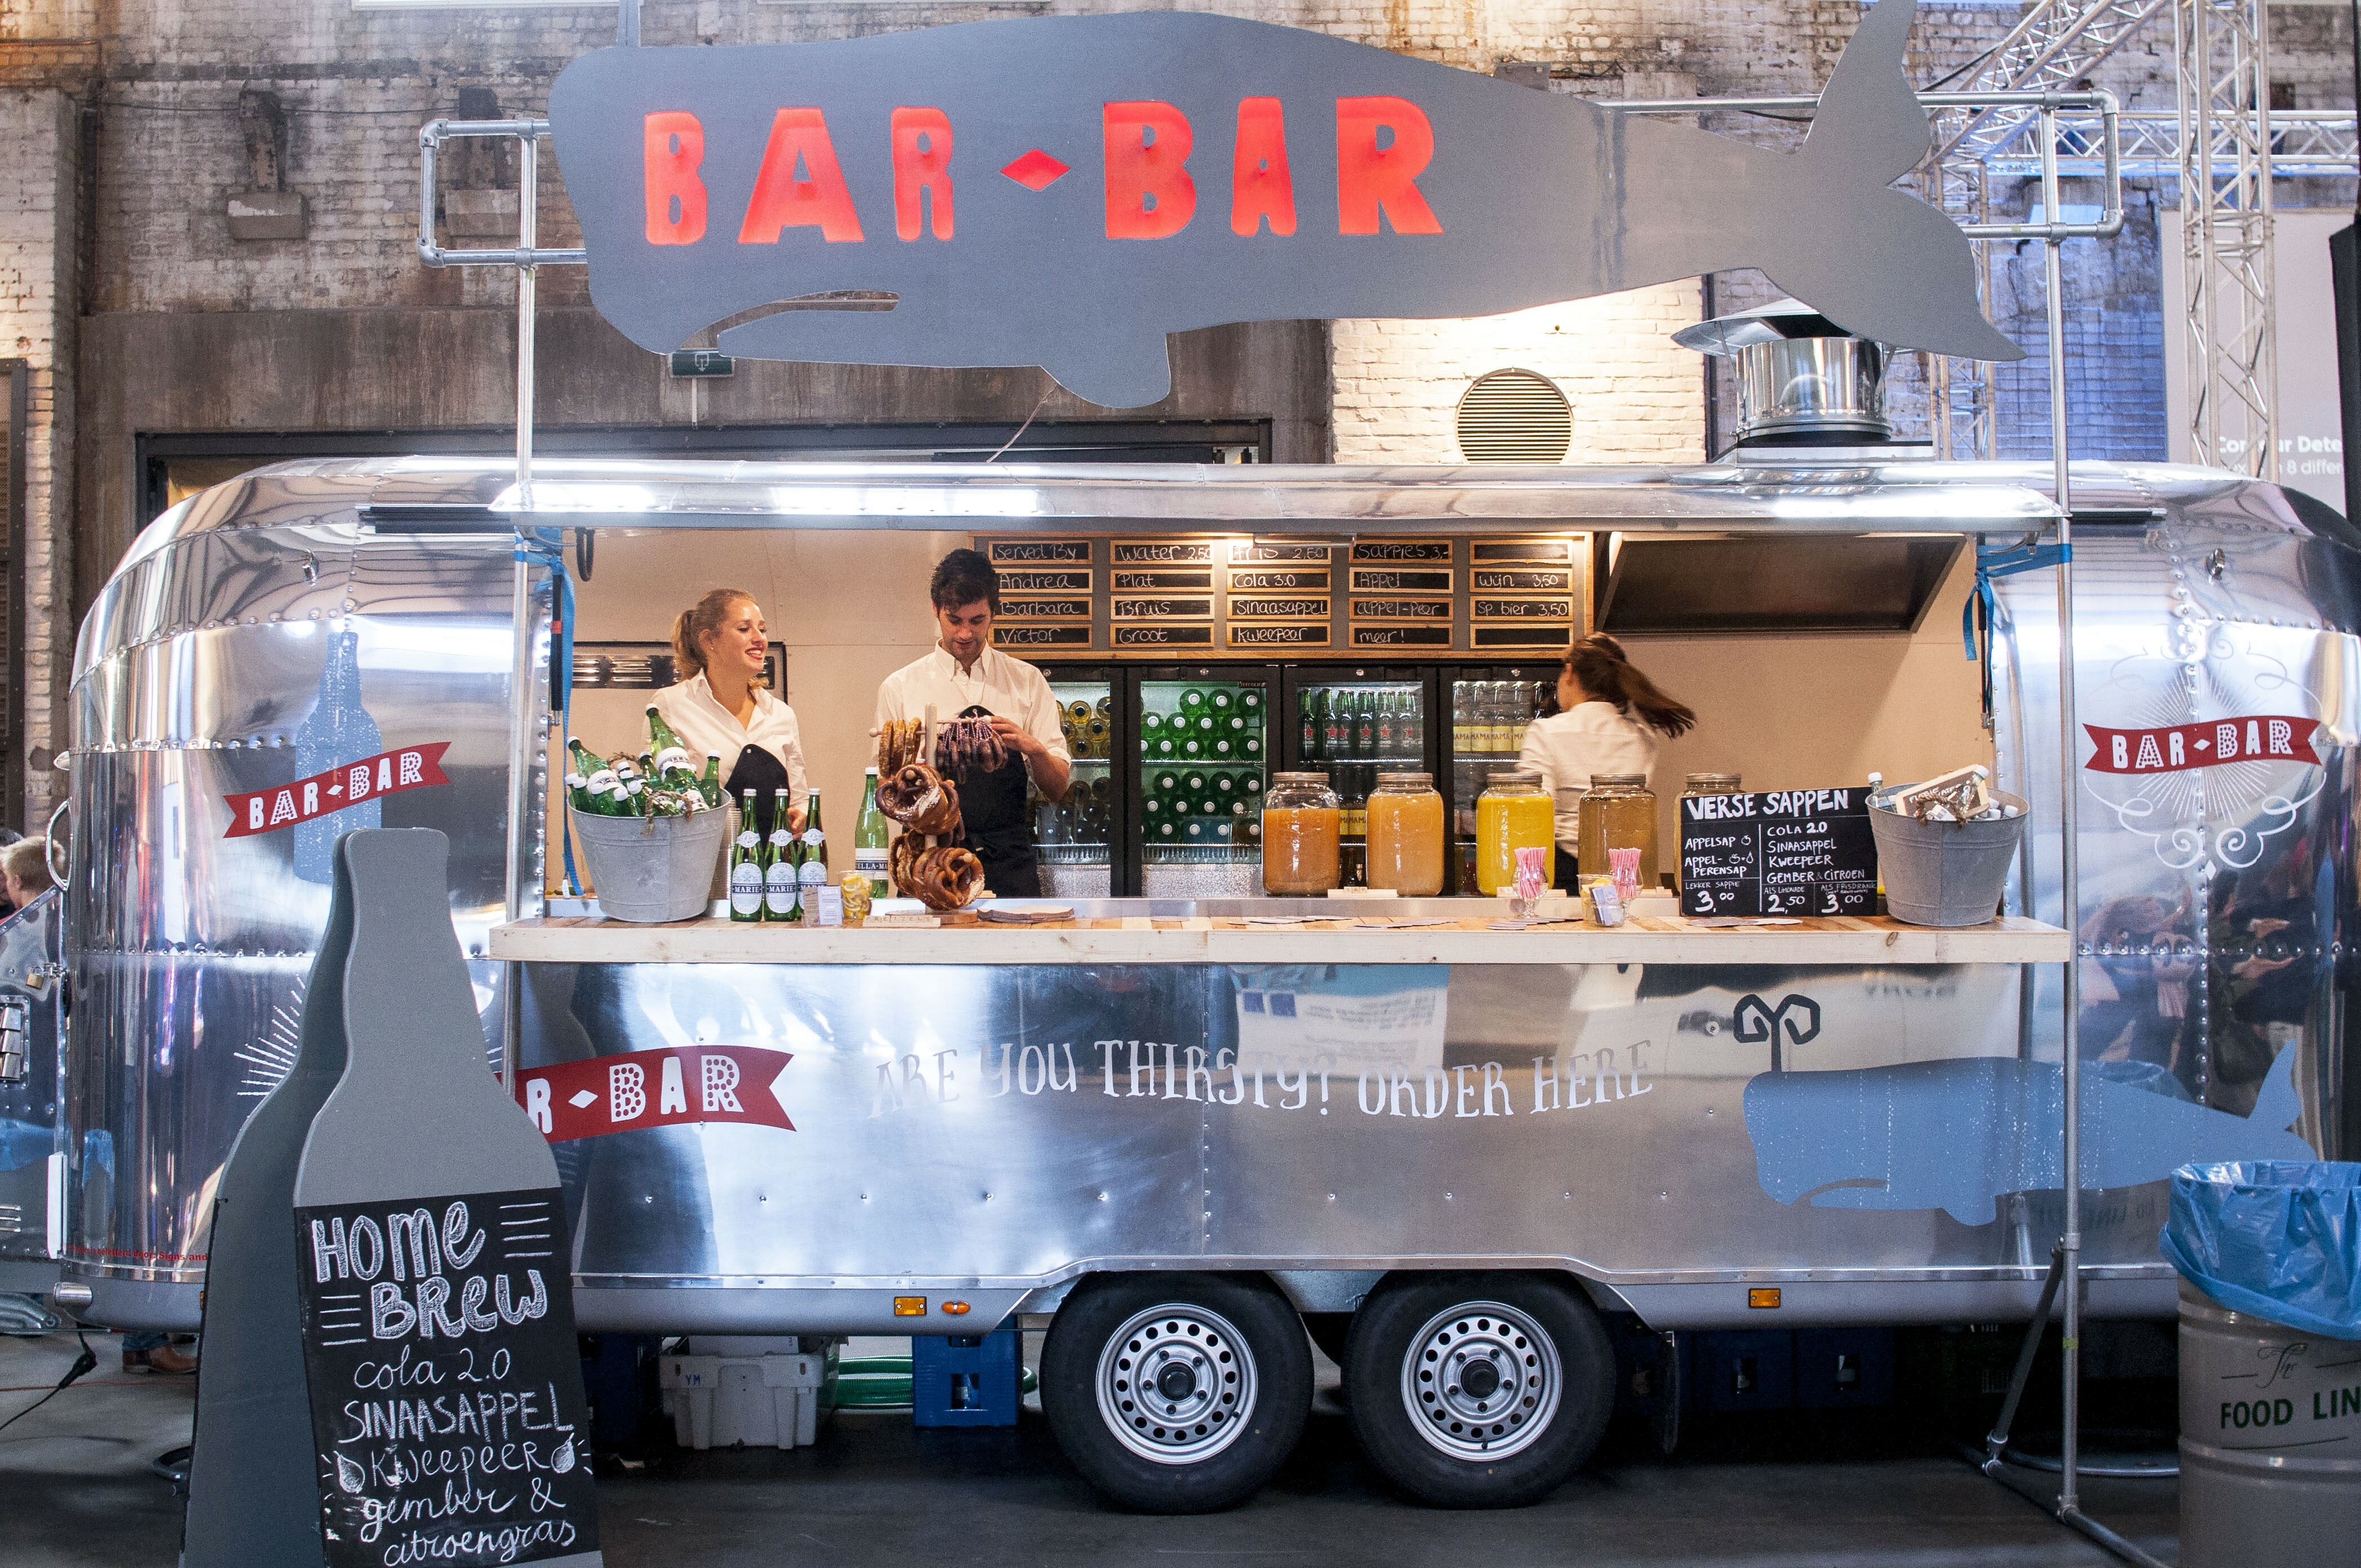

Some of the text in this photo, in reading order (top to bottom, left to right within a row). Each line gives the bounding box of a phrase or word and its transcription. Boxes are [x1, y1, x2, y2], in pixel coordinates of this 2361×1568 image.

[643, 96, 1445, 245] BAR BAR
[995, 543, 1076, 562] Served By
[1119, 544, 1180, 561] Water
[999, 573, 1077, 590] Andrea
[1117, 574, 1156, 588] Plat
[1234, 573, 1296, 587] Cola 3.0
[1532, 574, 1559, 588] 3,50
[1000, 600, 1080, 615] Barbara
[1118, 601, 1171, 617] Bruis
[1538, 603, 1567, 617] 3,50
[1001, 627, 1061, 644] Victor
[1119, 627, 1168, 643] Groot
[2112, 719, 2293, 769] BAR BAR
[249, 751, 423, 830] BAR BAR
[1686, 790, 1849, 820] VERSE SAPPEN
[1767, 821, 1828, 837] COLA 2.0
[1685, 836, 1736, 851] APPELSAP
[1766, 838, 1837, 855] SINAASAPPEL
[1684, 856, 1722, 868] APPEL-
[1769, 854, 1834, 868] KWEEPEER
[1693, 866, 1747, 878] PERENSAP
[1767, 871, 1815, 884] GEMBER
[1685, 881, 1711, 890] LEKKER
[1763, 886, 1776, 894] ALS
[866, 1039, 1653, 1119] ARE YOU THIRSTY? ORDER HERE
[609, 1055, 744, 1123] BAR
[354, 1344, 511, 1390] cola 2.0
[338, 1382, 575, 1444] SINAASAPPEL
[2221, 1398, 2294, 1429] FOOD
[360, 1477, 566, 1543] gember &
[384, 1519, 576, 1567] citroengras
